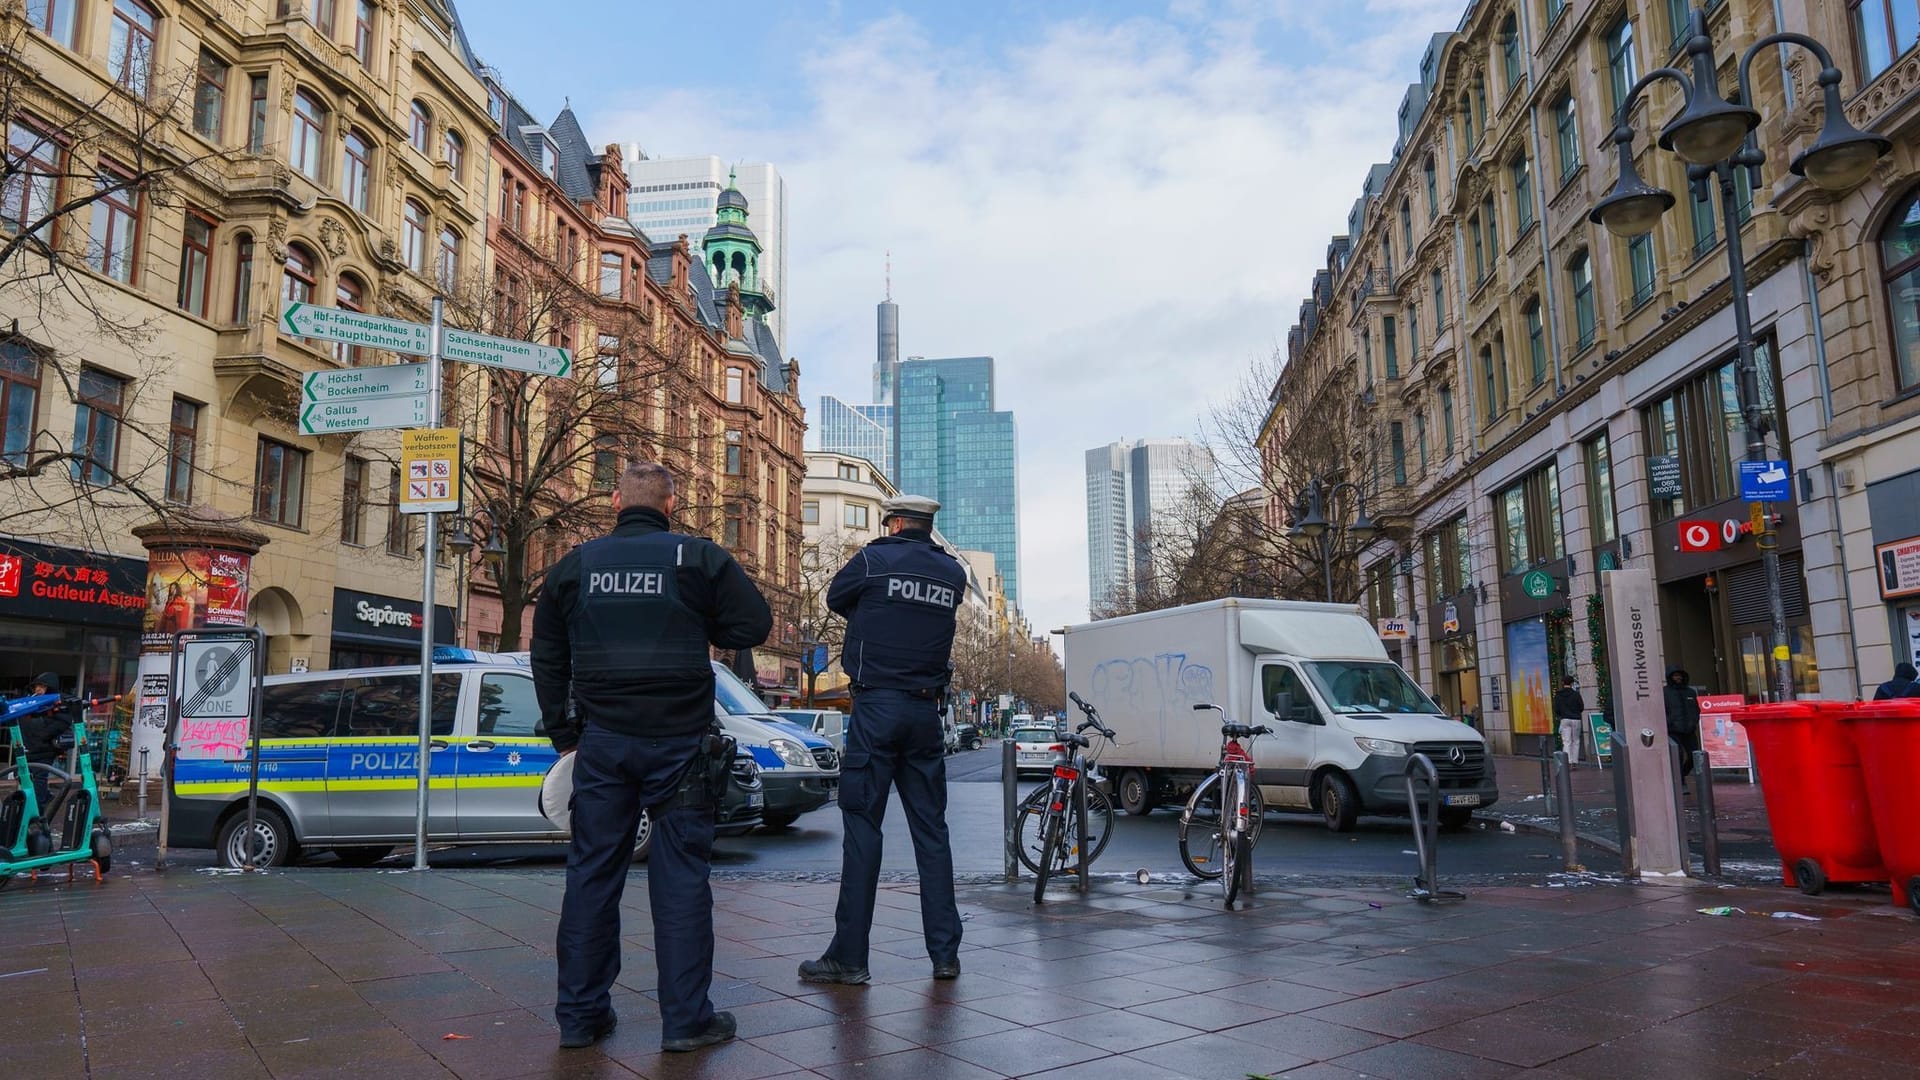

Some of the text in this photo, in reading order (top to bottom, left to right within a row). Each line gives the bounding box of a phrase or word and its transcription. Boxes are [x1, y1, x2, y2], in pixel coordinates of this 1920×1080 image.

[314, 311, 408, 335] Hbf-Fahrradparkhaus
[329, 326, 411, 349] Hauptbahnhof
[448, 333, 530, 356] Sachsenhausen
[447, 345, 503, 363] Innenstadt
[328, 373, 362, 384] Höchst
[327, 383, 389, 396] Bockenheim
[325, 406, 358, 416] Gallus
[325, 416, 370, 428] Westend
[414, 433, 449, 442] Waffen-
[404, 442, 457, 451] verbotszone
[588, 571, 663, 595] POLIZEI
[32, 580, 95, 602] Gutleut
[887, 577, 955, 609] POLIZEI
[1386, 620, 1404, 631] dm
[1630, 606, 1650, 701] Trinkwasser
[198, 700, 233, 713] ZONE
[263, 761, 278, 773] 110
[350, 752, 432, 771] POLIZE
